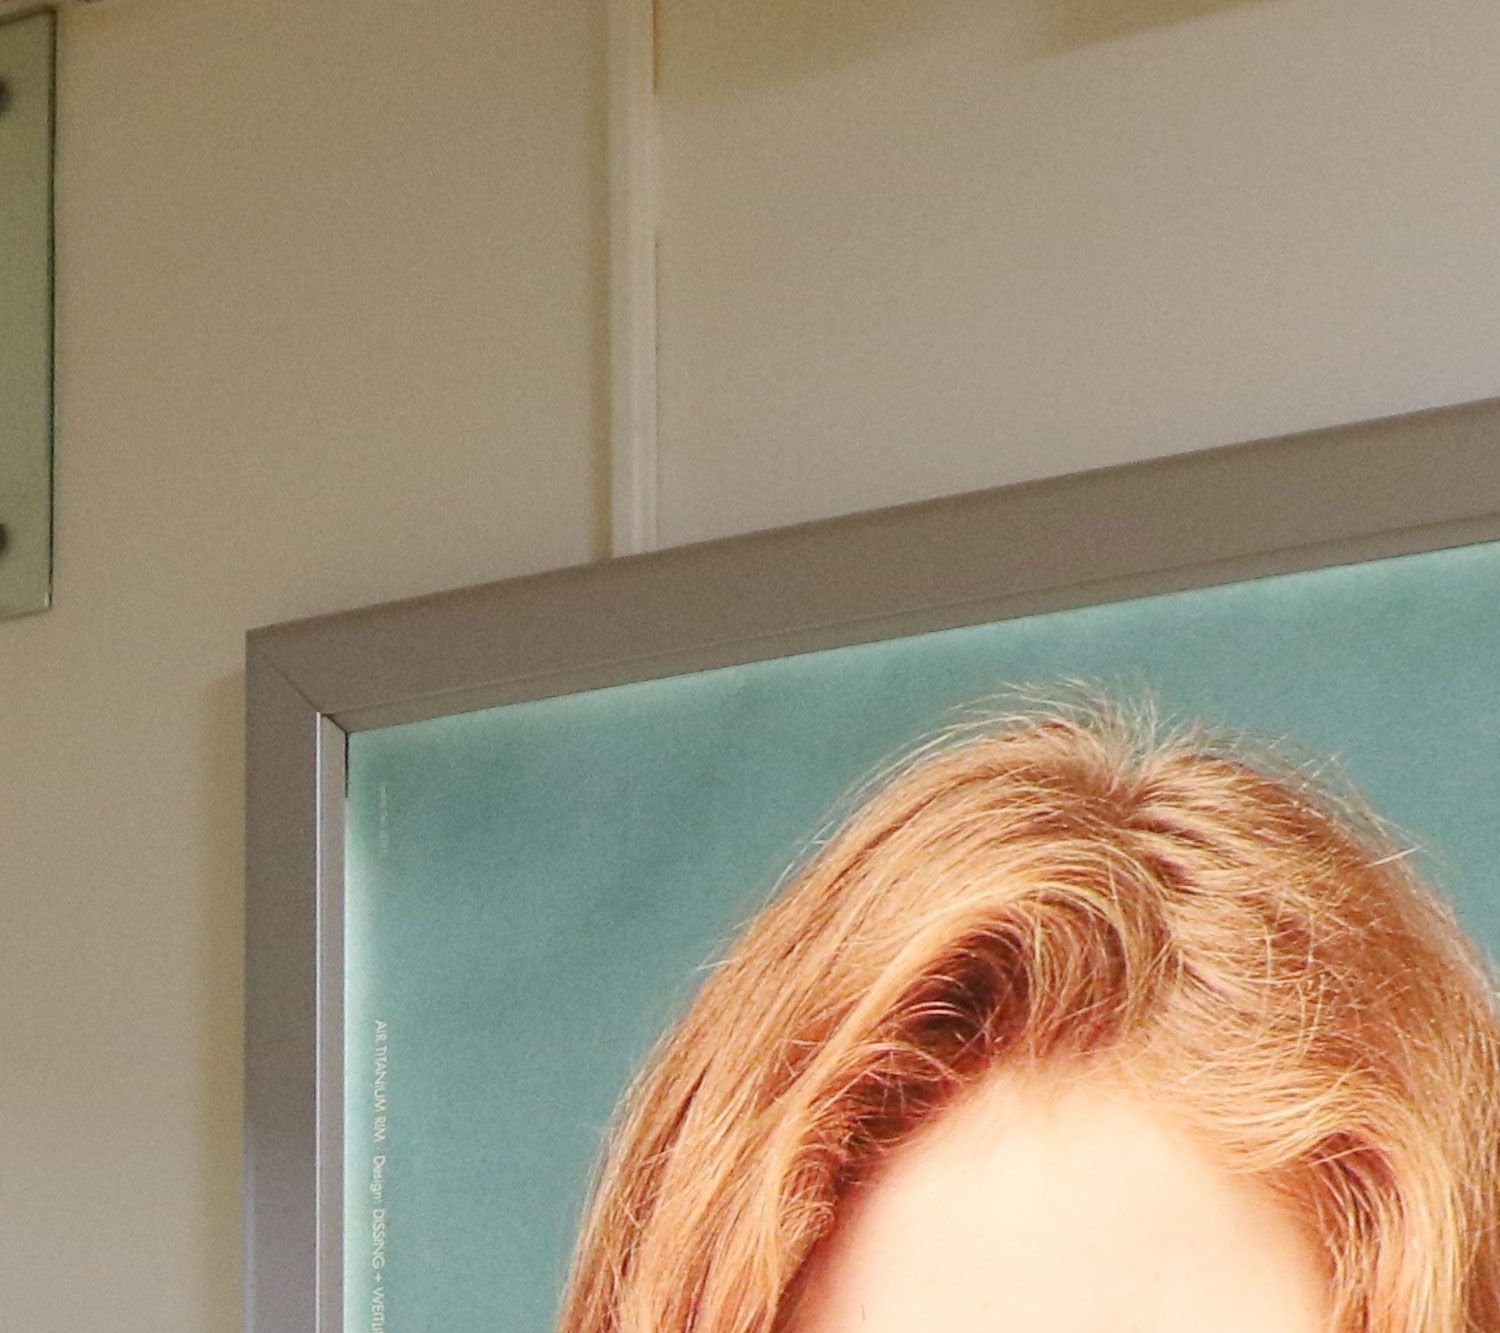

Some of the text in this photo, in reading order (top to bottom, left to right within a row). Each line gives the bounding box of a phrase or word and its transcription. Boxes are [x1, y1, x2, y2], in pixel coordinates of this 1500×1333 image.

[374, 1020, 388, 1042] AIR
[373, 1045, 388, 1113] TITANIUM
[373, 1117, 387, 1143] RIM
[372, 1208, 386, 1269] DISSING
